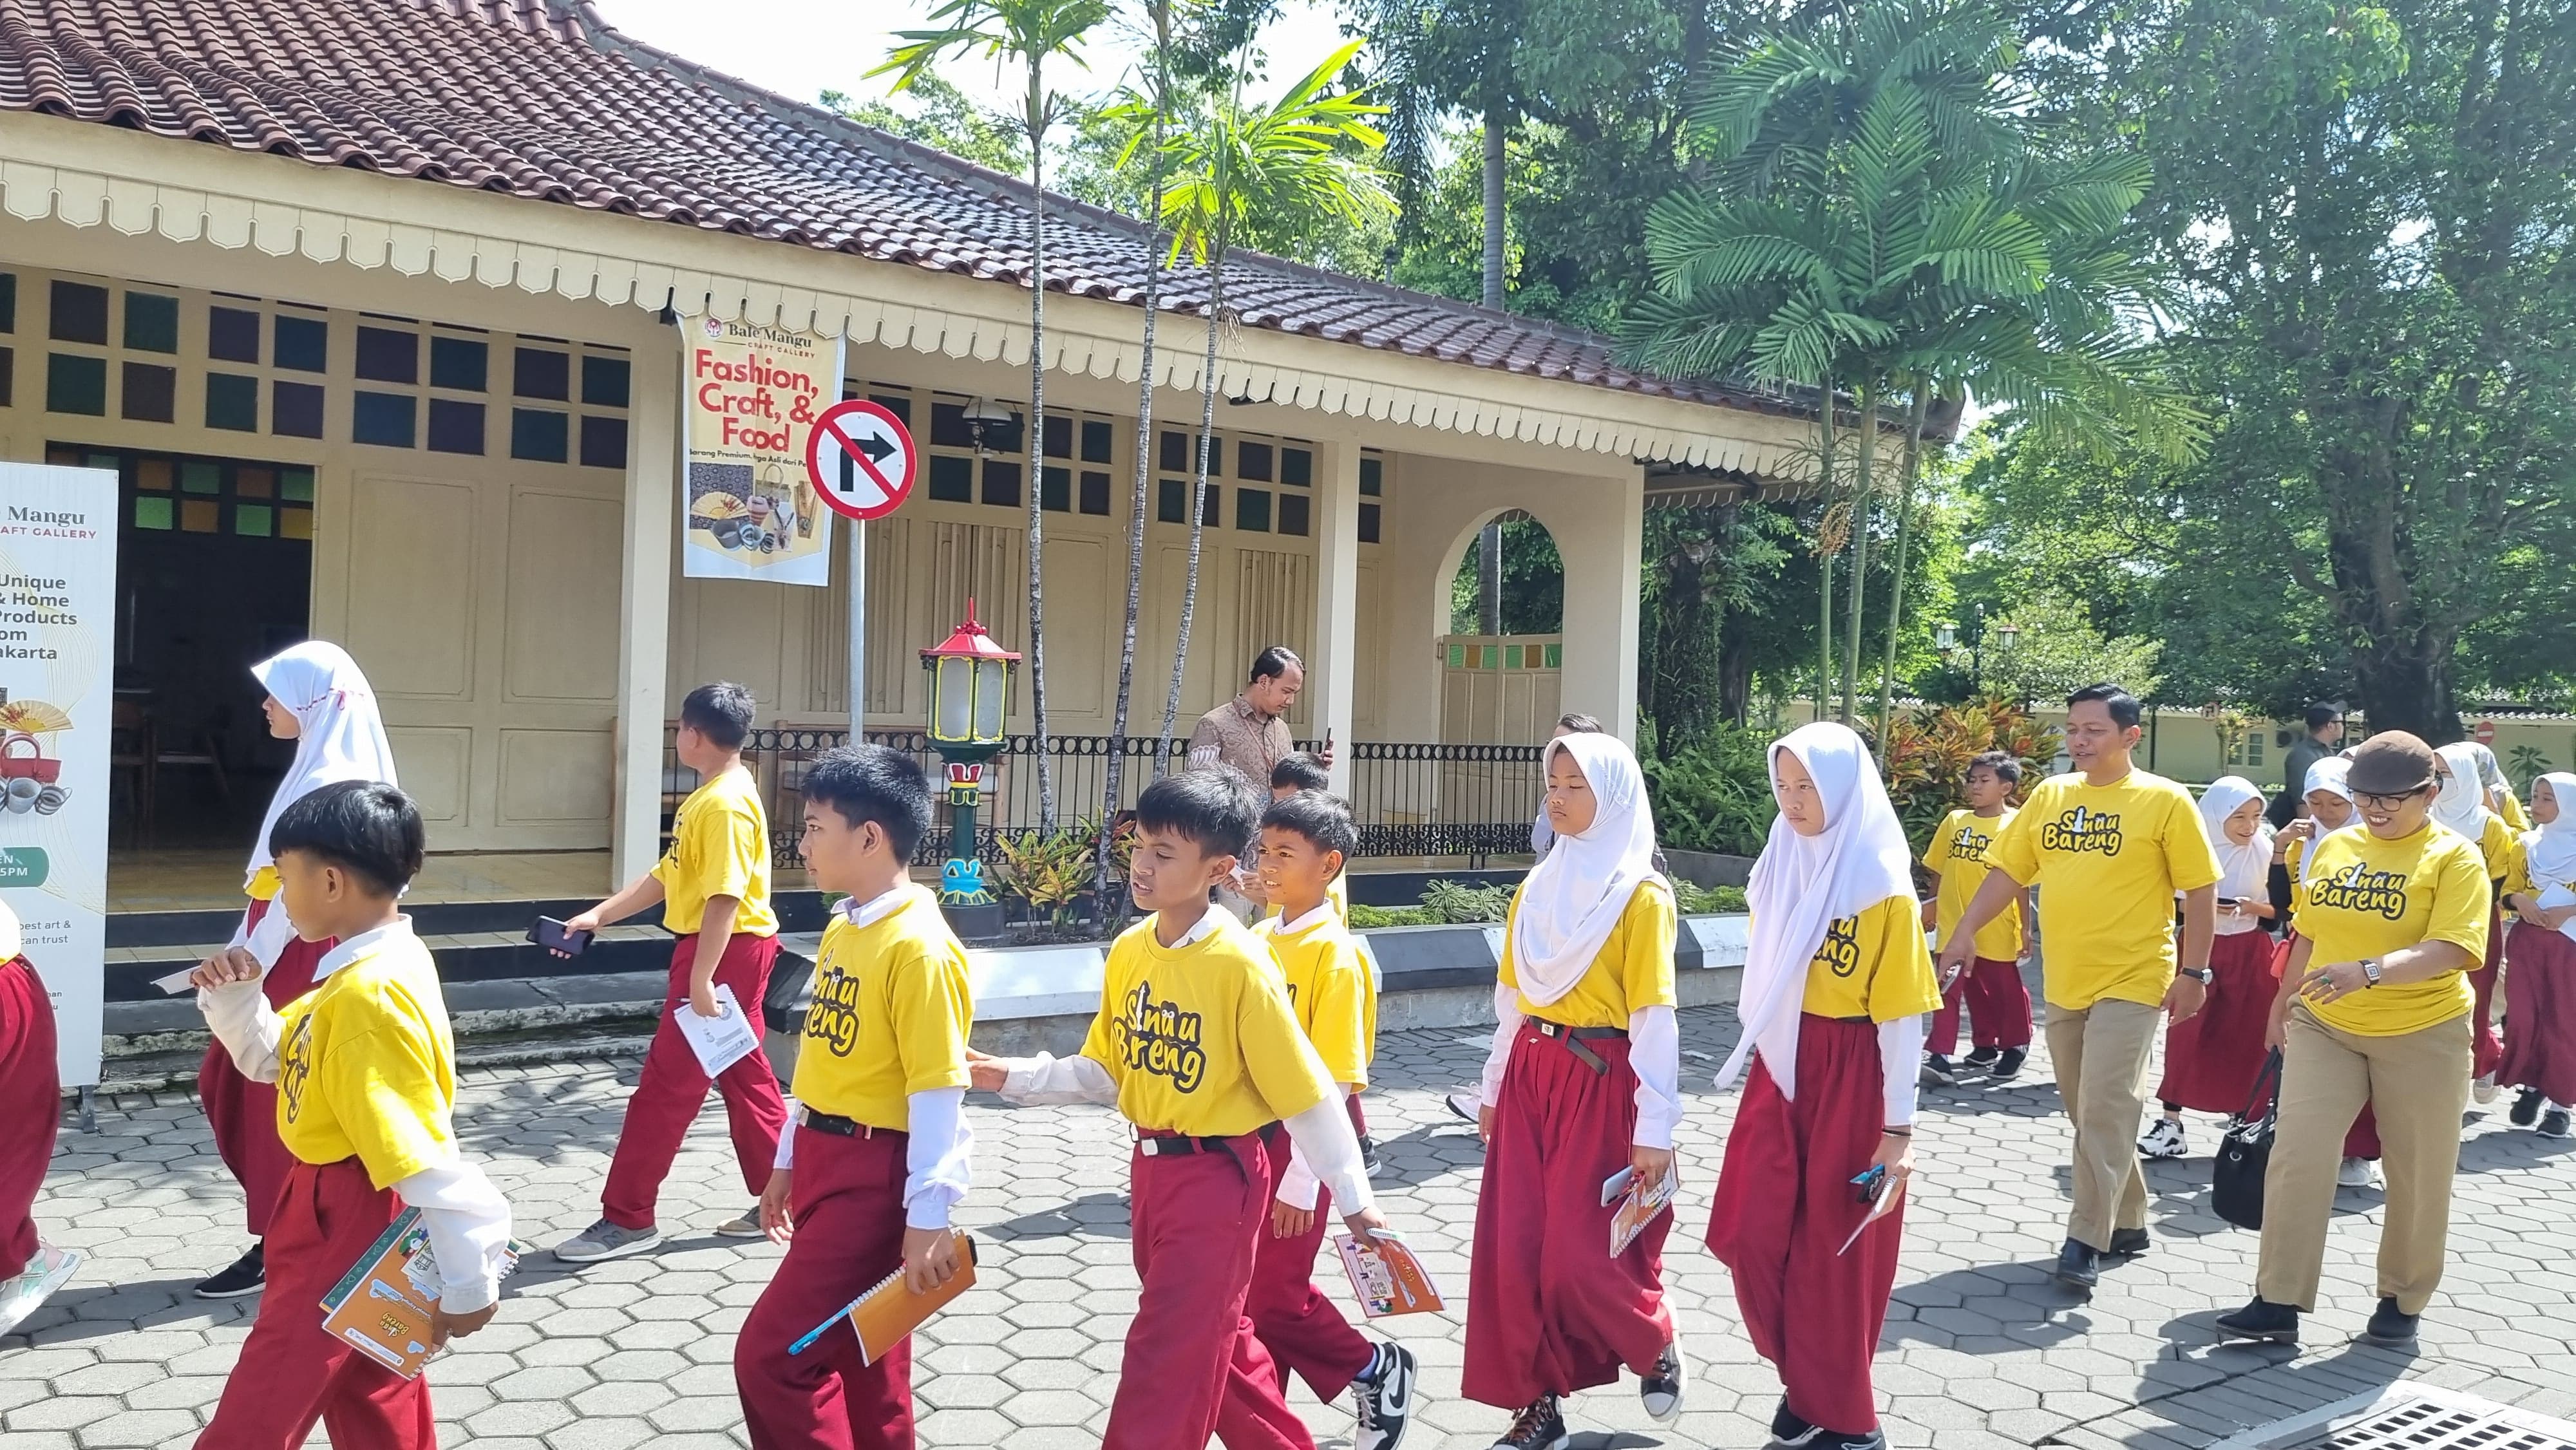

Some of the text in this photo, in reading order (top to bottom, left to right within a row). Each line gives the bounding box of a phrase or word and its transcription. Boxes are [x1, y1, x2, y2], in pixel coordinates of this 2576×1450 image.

[730, 324, 811, 349] Bale Mangu
[696, 349, 819, 399] Fashion,
[699, 382, 815, 425] Craft, &
[723, 417, 790, 453] Food
[8, 505, 86, 528] Mangu
[33, 528, 97, 539] GALLERY
[0, 574, 66, 592] Unique
[13, 592, 70, 607] Home
[0, 610, 77, 625] roducts
[2060, 805, 2120, 835] Sinau
[2042, 823, 2123, 857] Bareng
[2333, 862, 2407, 892] Sinau
[2309, 878, 2407, 921] Bareng
[44, 920, 61, 929] art
[64, 920, 71, 928] &
[42, 934, 68, 944] trust
